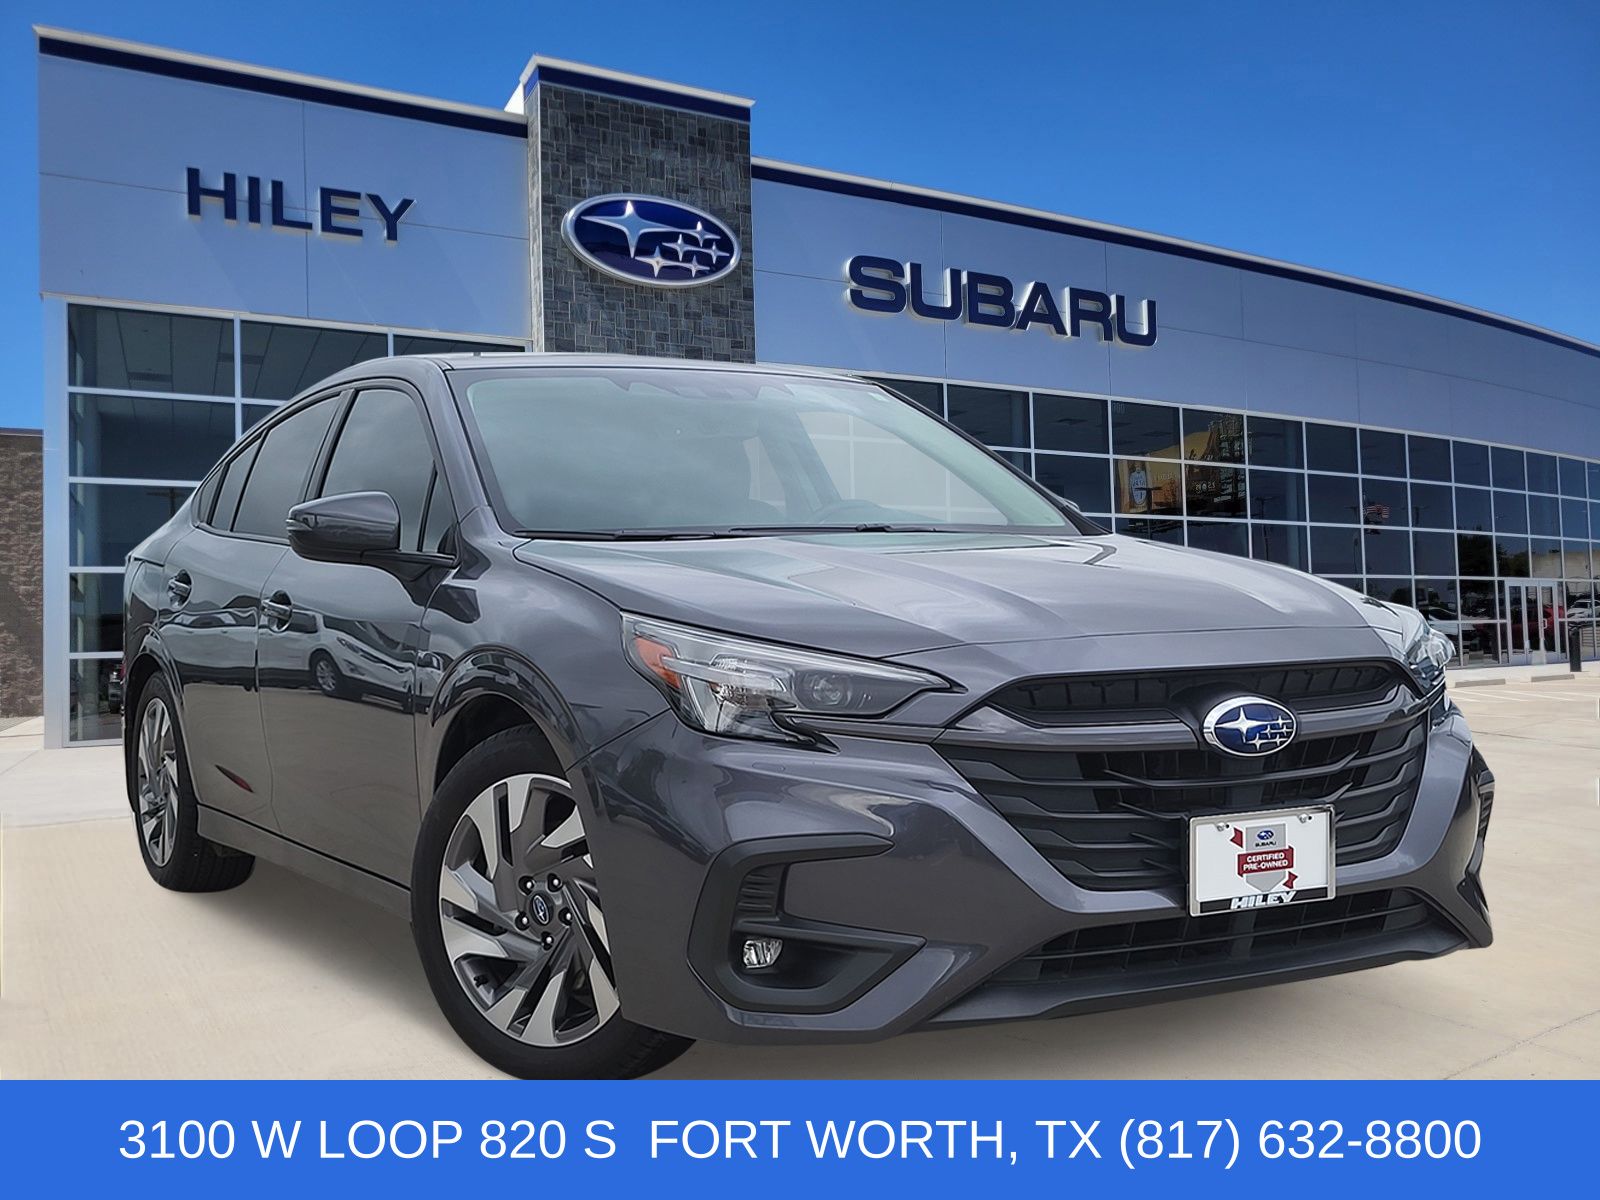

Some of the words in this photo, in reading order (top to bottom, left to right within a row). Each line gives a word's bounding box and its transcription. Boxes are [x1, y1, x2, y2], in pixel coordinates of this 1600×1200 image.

[186, 166, 416, 242] HILEY
[846, 254, 1157, 347] SUBARU
[1242, 859, 1289, 871] PRE-OWNED
[1246, 852, 1285, 863] CERTIFIED
[1230, 890, 1297, 910] HILEY
